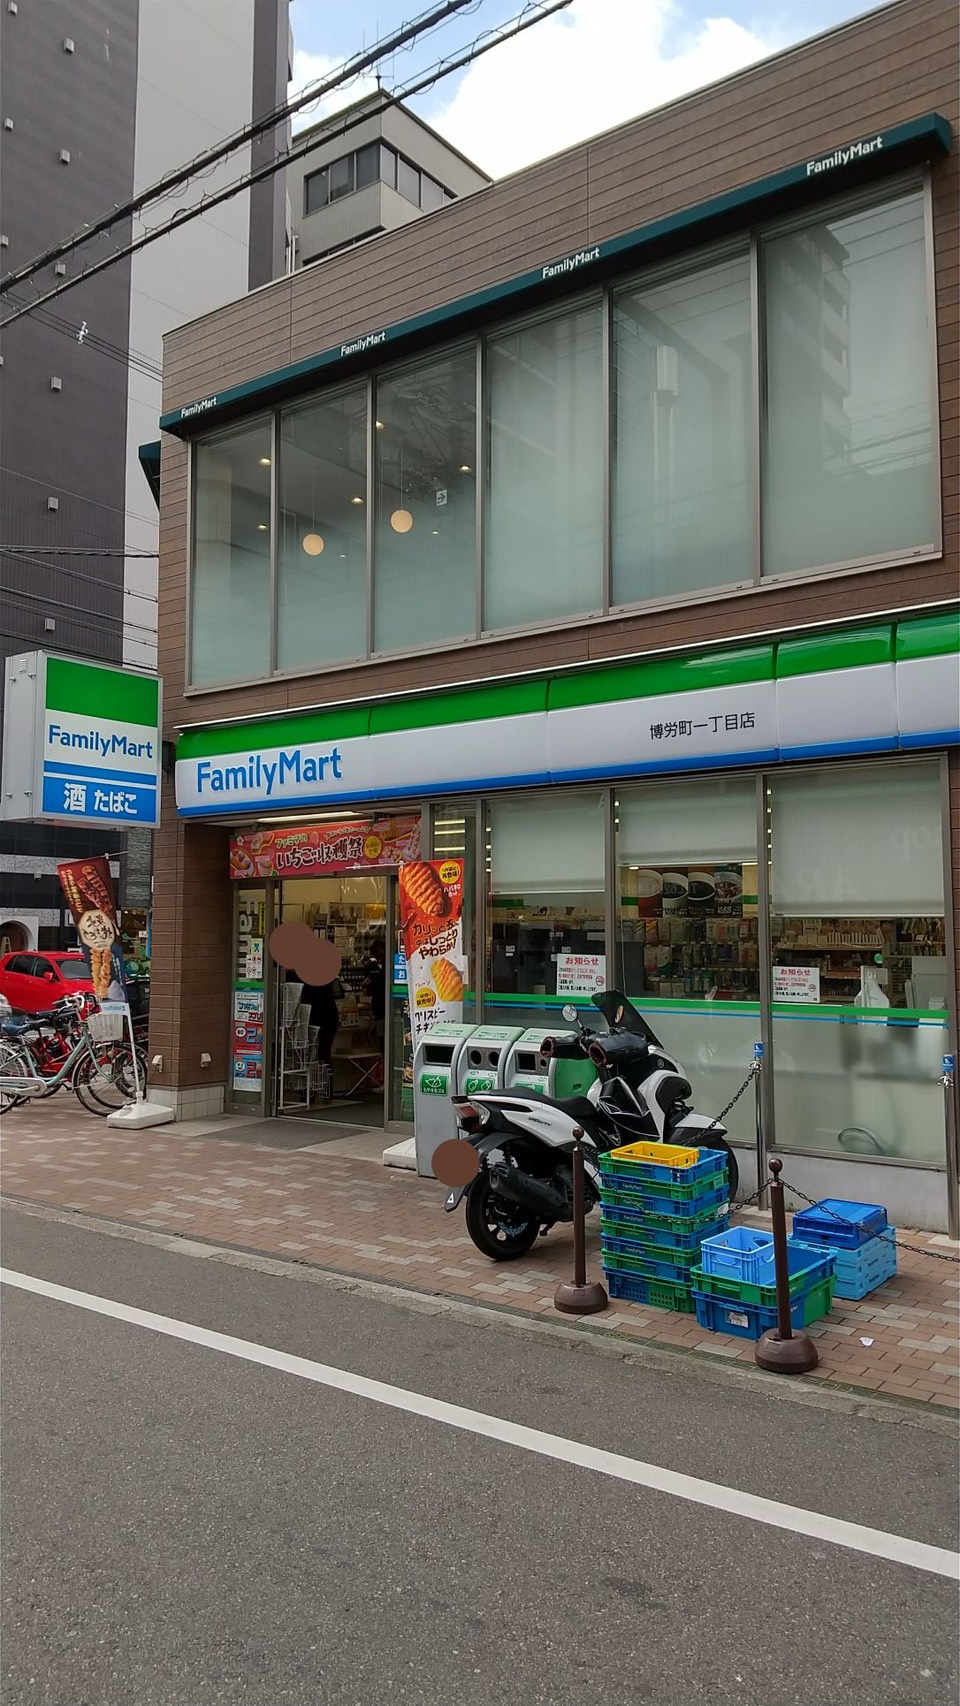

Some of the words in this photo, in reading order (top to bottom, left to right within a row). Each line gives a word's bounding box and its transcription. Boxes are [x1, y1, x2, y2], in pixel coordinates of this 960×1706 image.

[806, 136, 883, 176] FamilyMart
[543, 246, 600, 279] FamilyMart
[341, 331, 386, 357] FamilyMart
[180, 396, 217, 418] FamilyMart
[649, 711, 756, 740] 博労町一丁目店
[48, 724, 153, 759] FamilyMart
[197, 747, 342, 796] FamilyMart
[63, 782, 87, 812] 酒
[93, 789, 138, 814] たばこ
[276, 836, 363, 869] いちご収穫祭
[565, 957, 600, 966] お知らせ
[780, 968, 811, 976] お知らせ
[414, 1007, 446, 1022] クリスピー
